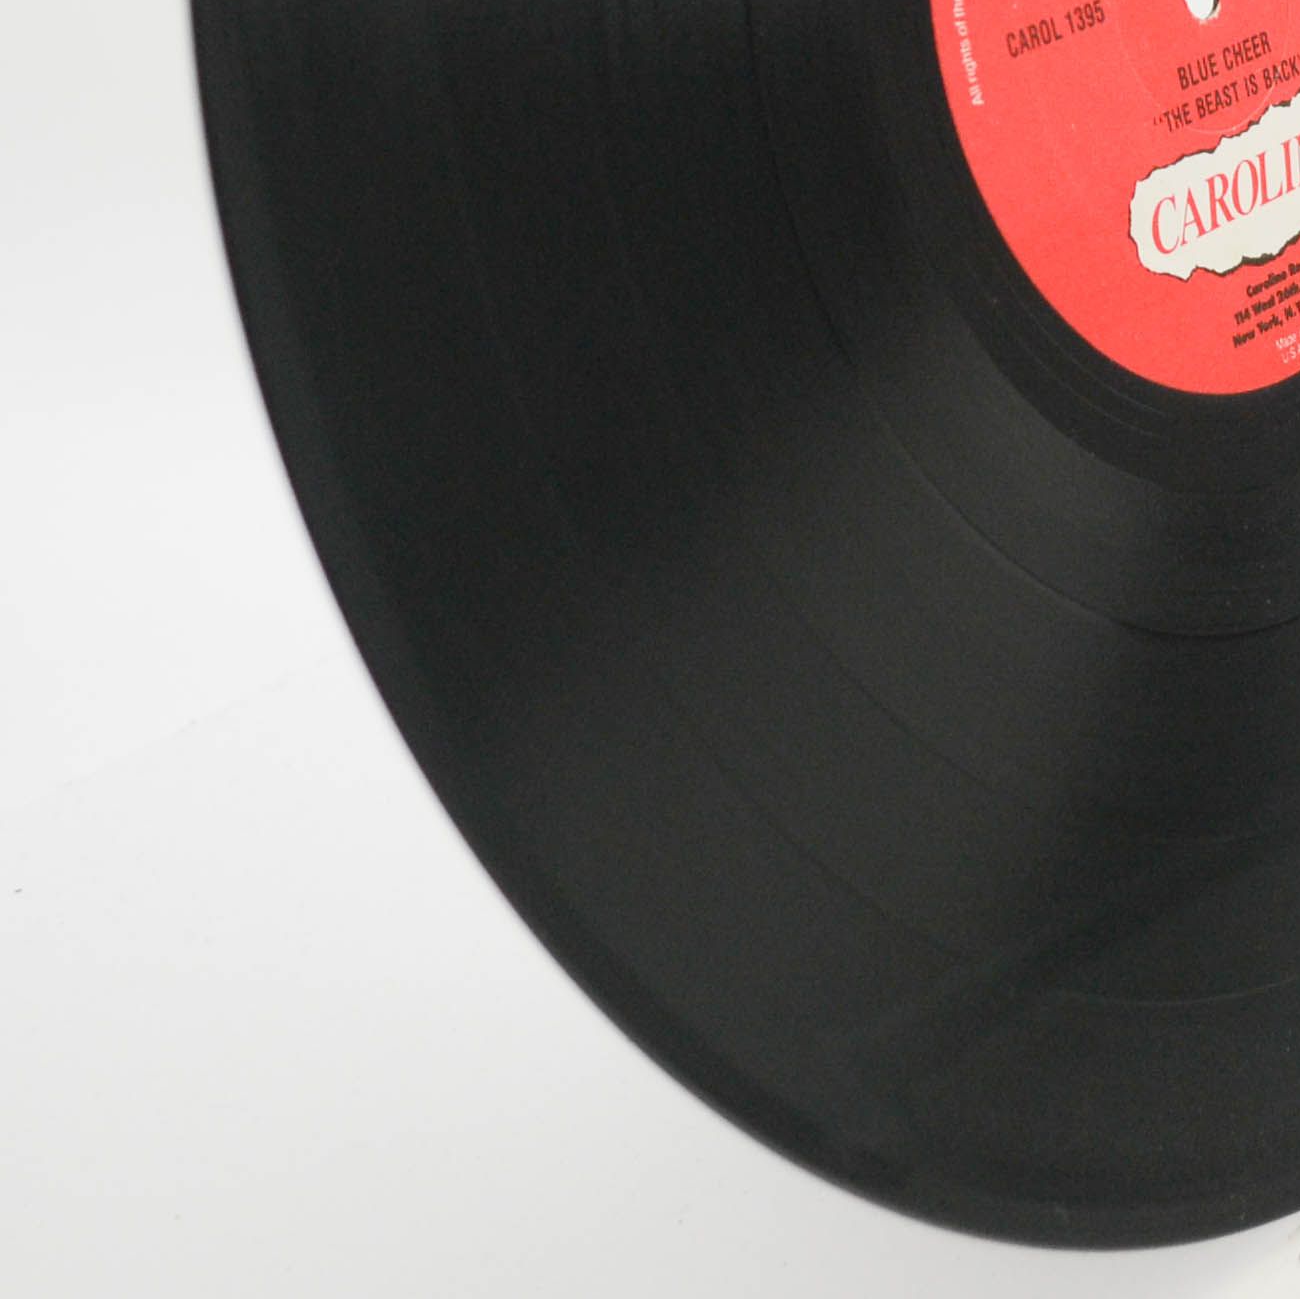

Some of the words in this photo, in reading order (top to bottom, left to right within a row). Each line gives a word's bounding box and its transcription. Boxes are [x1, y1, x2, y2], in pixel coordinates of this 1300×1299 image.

[955, 21, 968, 36] of
[1006, 17, 1063, 58] CAROL
[1064, 0, 1105, 33] 1395
[960, 39, 977, 83] rights
[1177, 52, 1219, 91] BLUE
[1223, 31, 1271, 71] CHEER
[969, 84, 984, 105] All
[1196, 80, 1240, 119] BEAST
[1245, 74, 1259, 97] IS
[1247, 271, 1287, 297] Caroline
[1251, 294, 1276, 316] West
[1233, 329, 1255, 348] New
